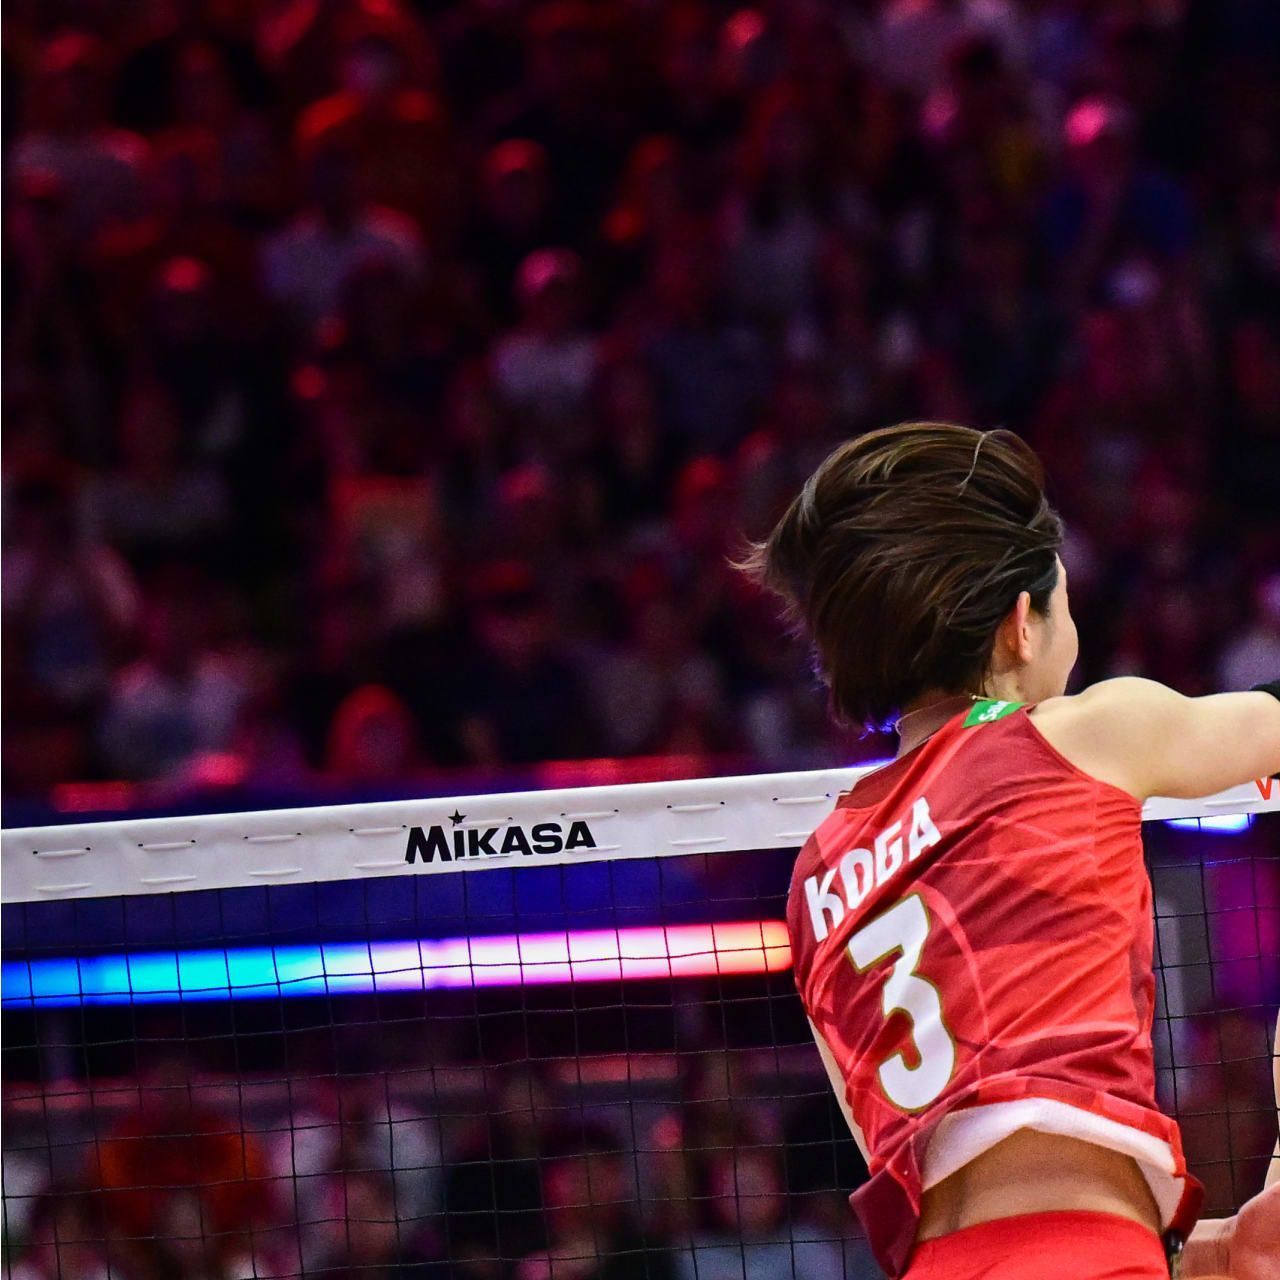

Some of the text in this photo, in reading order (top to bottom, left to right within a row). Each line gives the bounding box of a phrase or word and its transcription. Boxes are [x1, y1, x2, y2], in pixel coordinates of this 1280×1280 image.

[404, 819, 598, 865] MIKASA
[804, 796, 942, 943] KOGA
[847, 892, 956, 1115] 3
